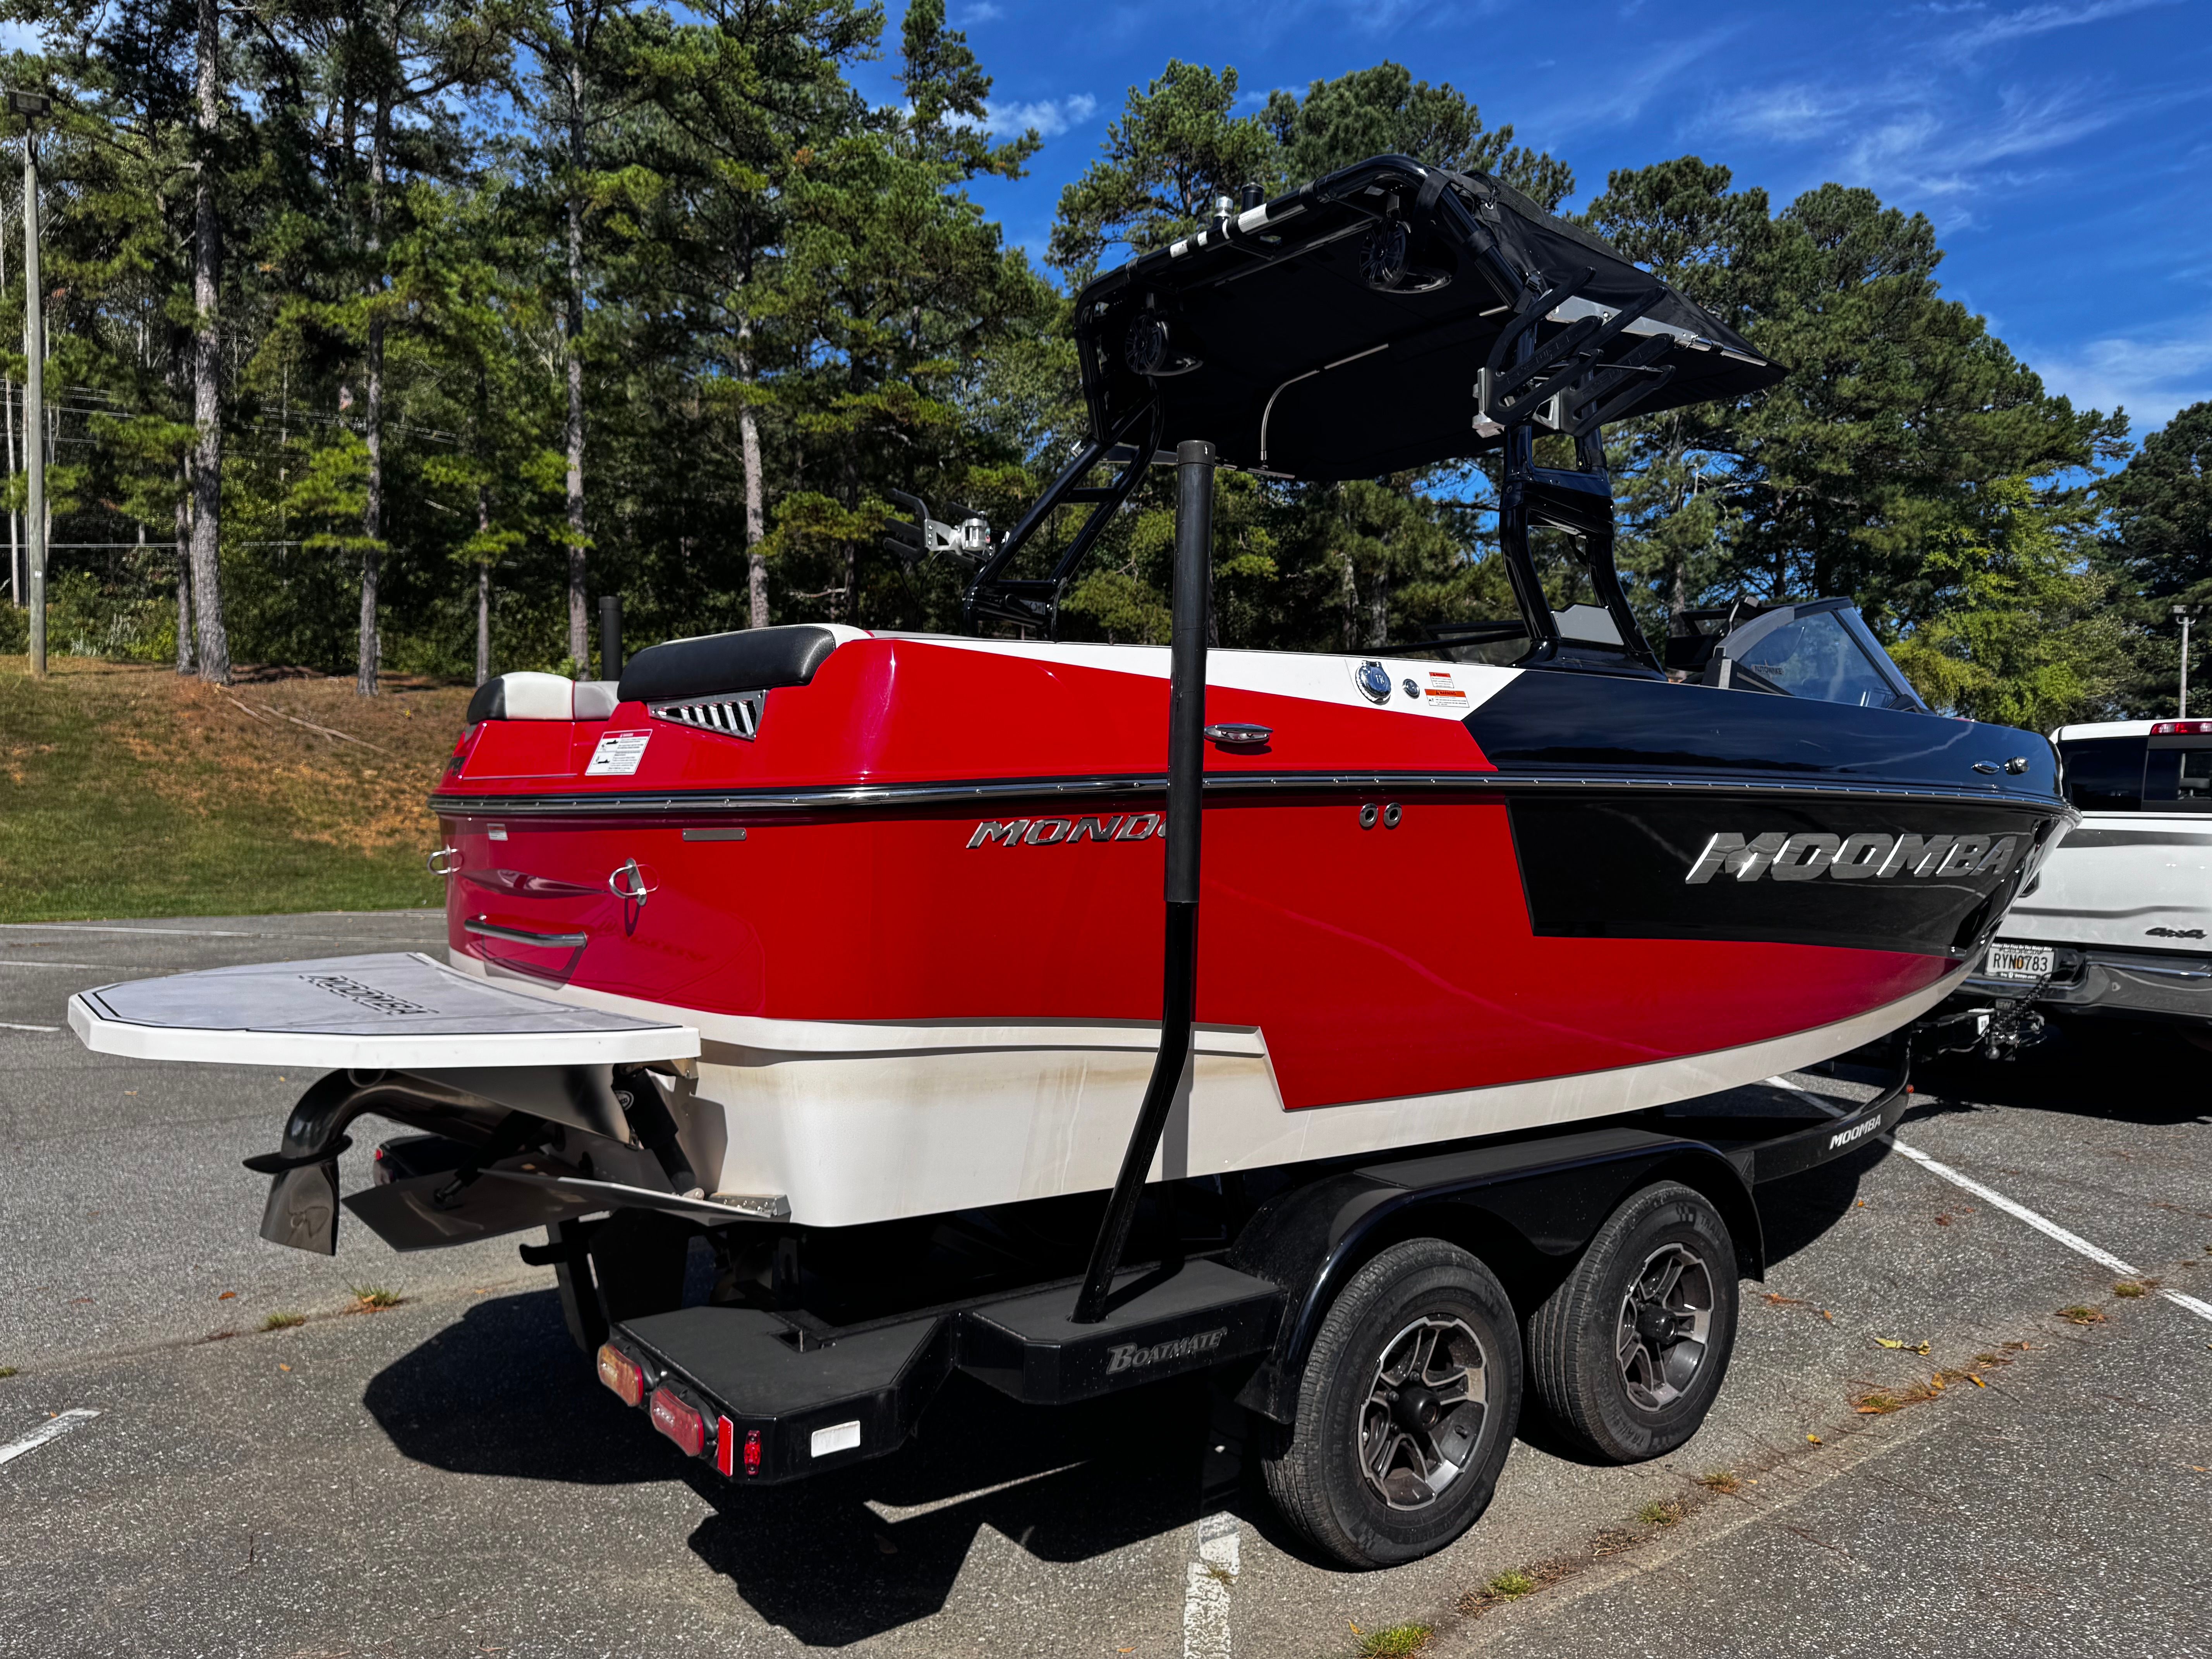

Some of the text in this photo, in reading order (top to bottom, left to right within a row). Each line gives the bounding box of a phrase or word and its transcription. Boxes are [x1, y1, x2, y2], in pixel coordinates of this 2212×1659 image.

[1685, 832, 2017, 883] MOOMBA
[1993, 953, 2048, 972] RYN0783
[1829, 1114, 1881, 1150] MOOMBA
[1106, 1328, 1224, 1374] BOATMATE
